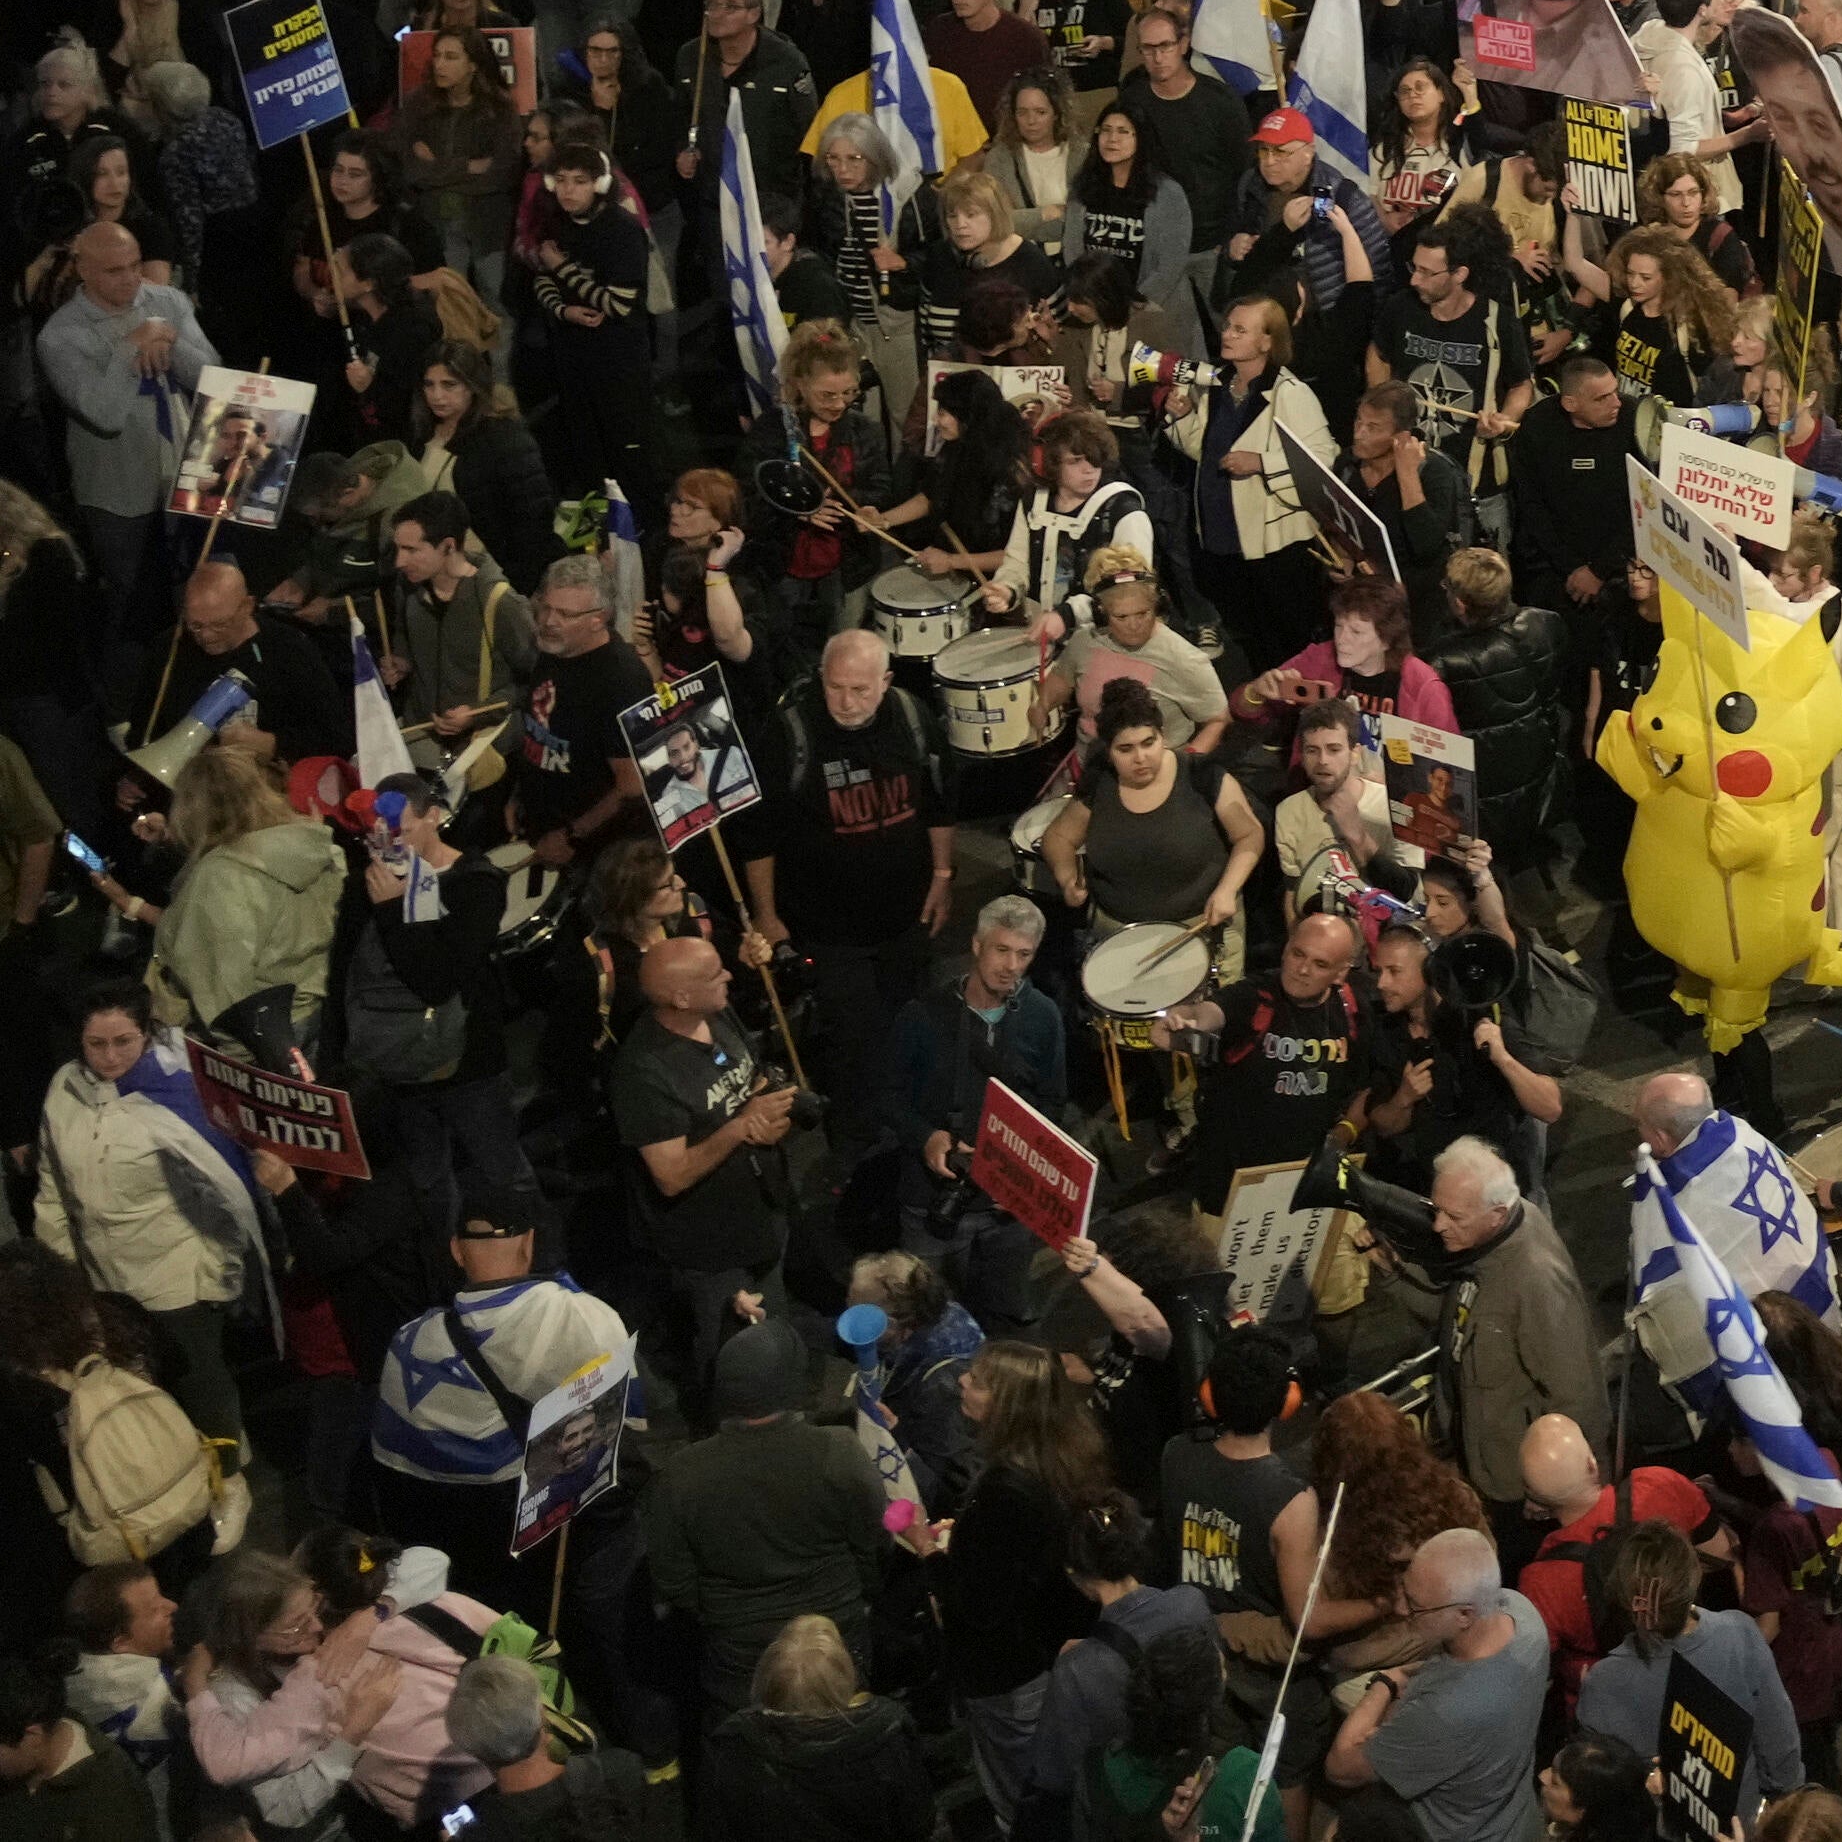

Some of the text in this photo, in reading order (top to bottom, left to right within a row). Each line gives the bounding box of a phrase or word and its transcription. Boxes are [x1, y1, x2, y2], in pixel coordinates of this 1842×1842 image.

[1491, 21, 1528, 39] עדיין
[1566, 101, 1585, 122] ALL
[1595, 106, 1625, 129] THEM
[1567, 122, 1626, 169] HOME
[1571, 162, 1637, 223] NOW!
[1405, 332, 1482, 366] RUSH
[1678, 452, 1777, 491] מי שלא קם מהספה
[1678, 465, 1774, 507] שלא יתלונן
[1662, 499, 1690, 542] עם
[1675, 483, 1775, 526] על החדשות
[205, 1058, 334, 1117] פעימה אחת
[1274, 1070, 1328, 1096] גאה
[986, 1112, 1080, 1201] עד שהם חוזרים
[1226, 1218, 1251, 1270] won't
[1236, 1210, 1277, 1308] let them
[1258, 1235, 1292, 1311] make us
[1669, 1700, 1735, 1780] מחזירים
[1682, 1750, 1713, 1797] ולא
